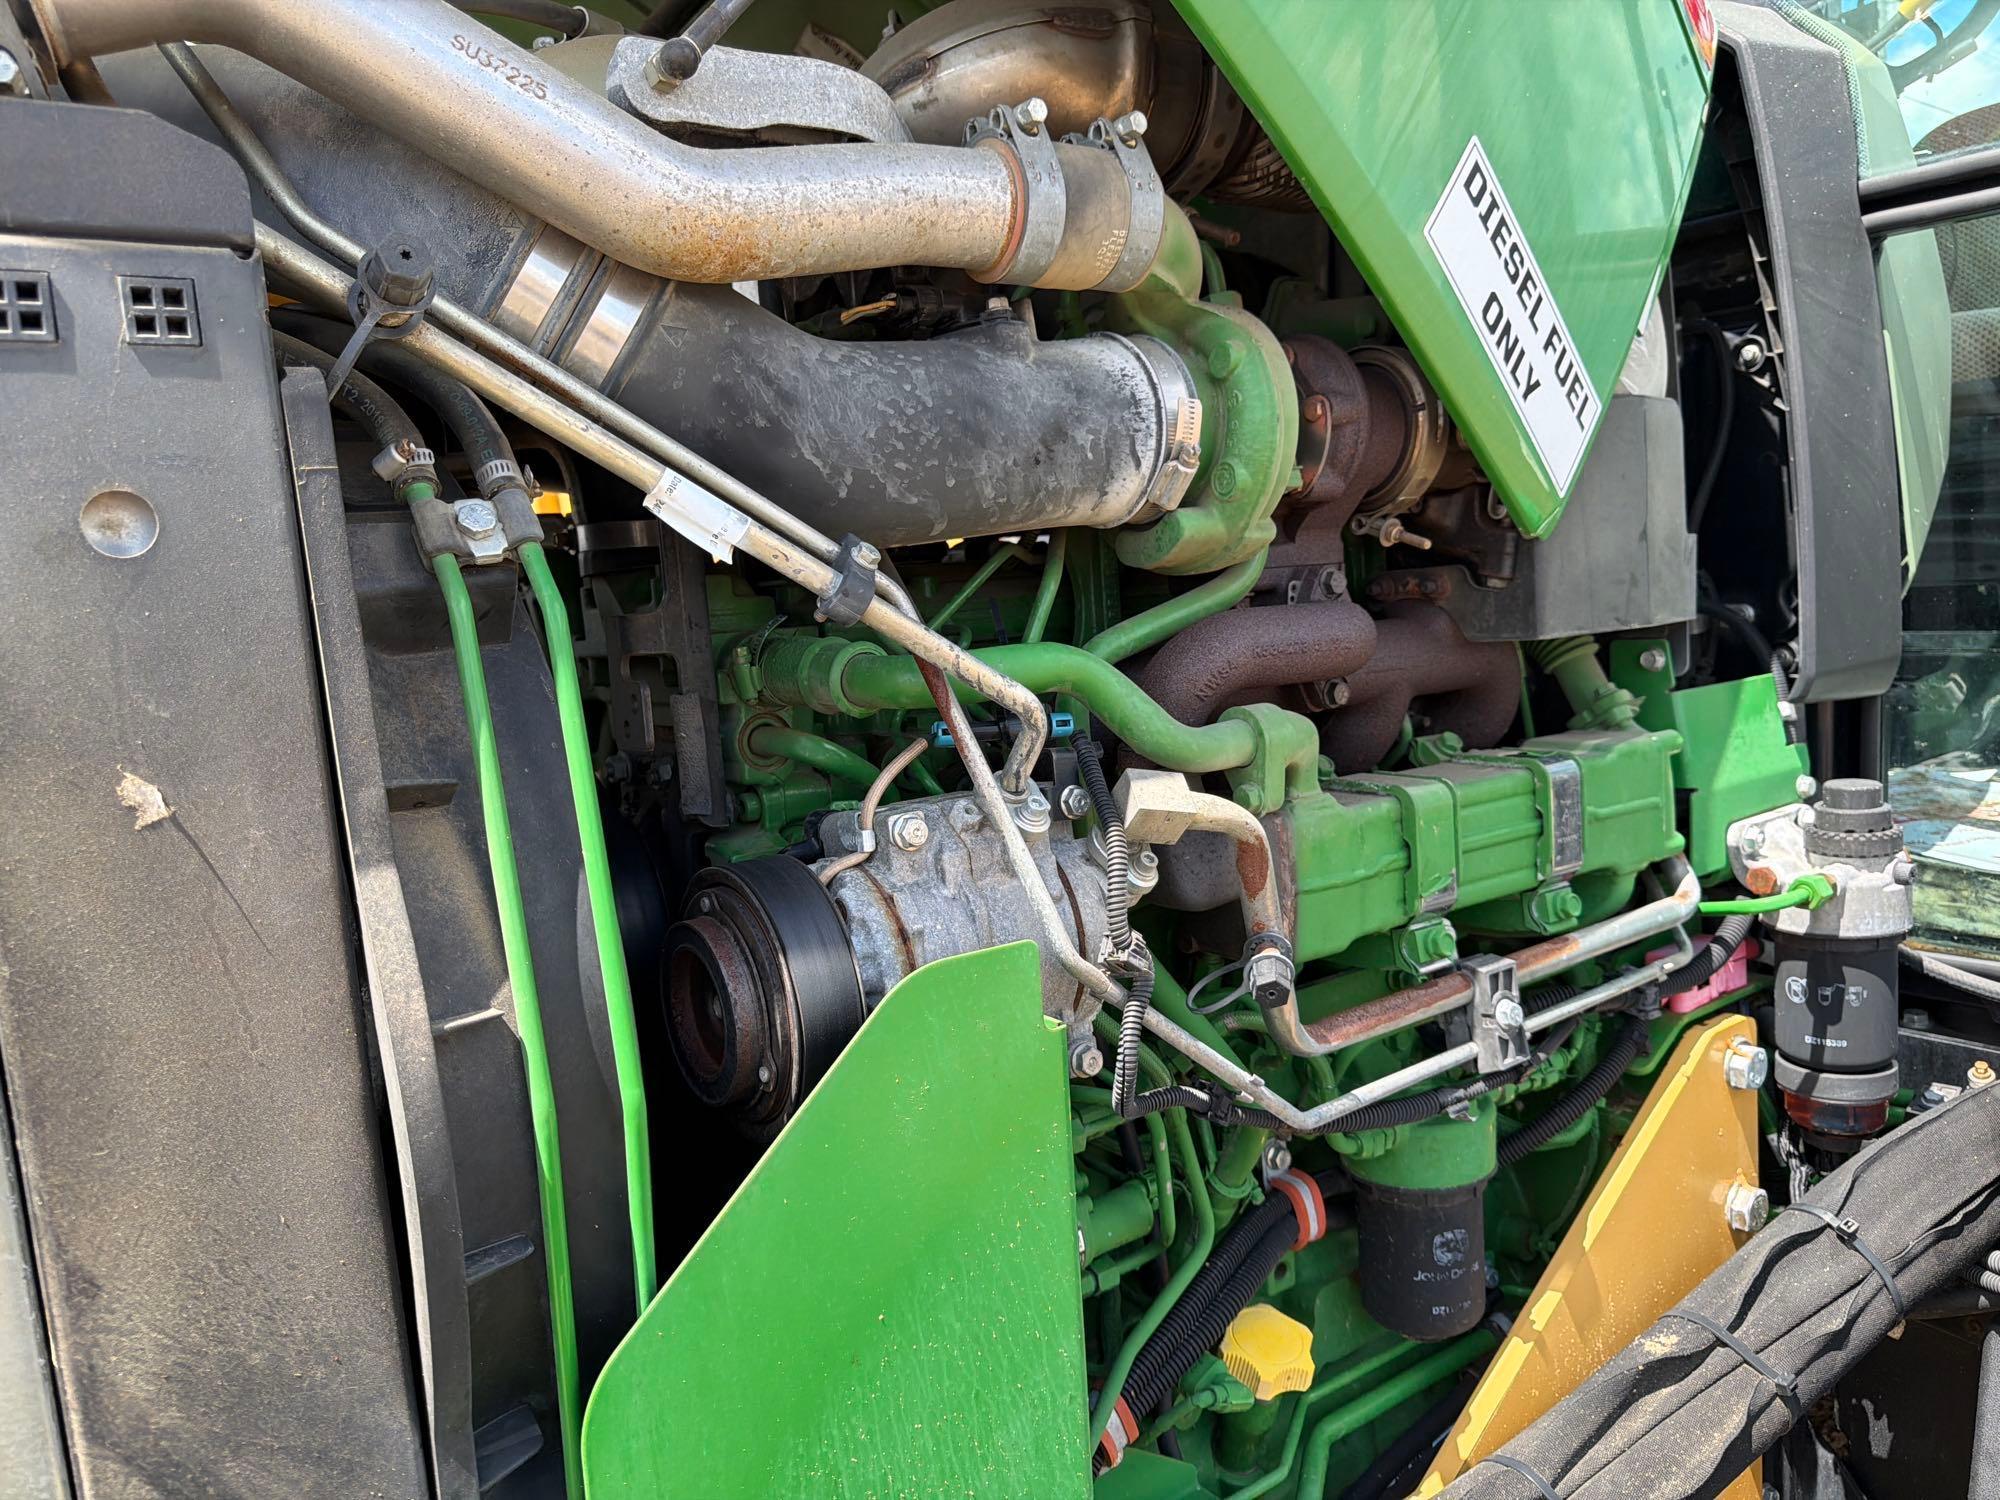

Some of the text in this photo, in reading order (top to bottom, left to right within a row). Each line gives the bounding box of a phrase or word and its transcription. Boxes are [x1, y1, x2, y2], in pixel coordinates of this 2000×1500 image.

[450, 33, 548, 100] SU37225
[1463, 160, 1591, 432] DIESEL FUEL
[1482, 291, 1541, 402] ONLY
